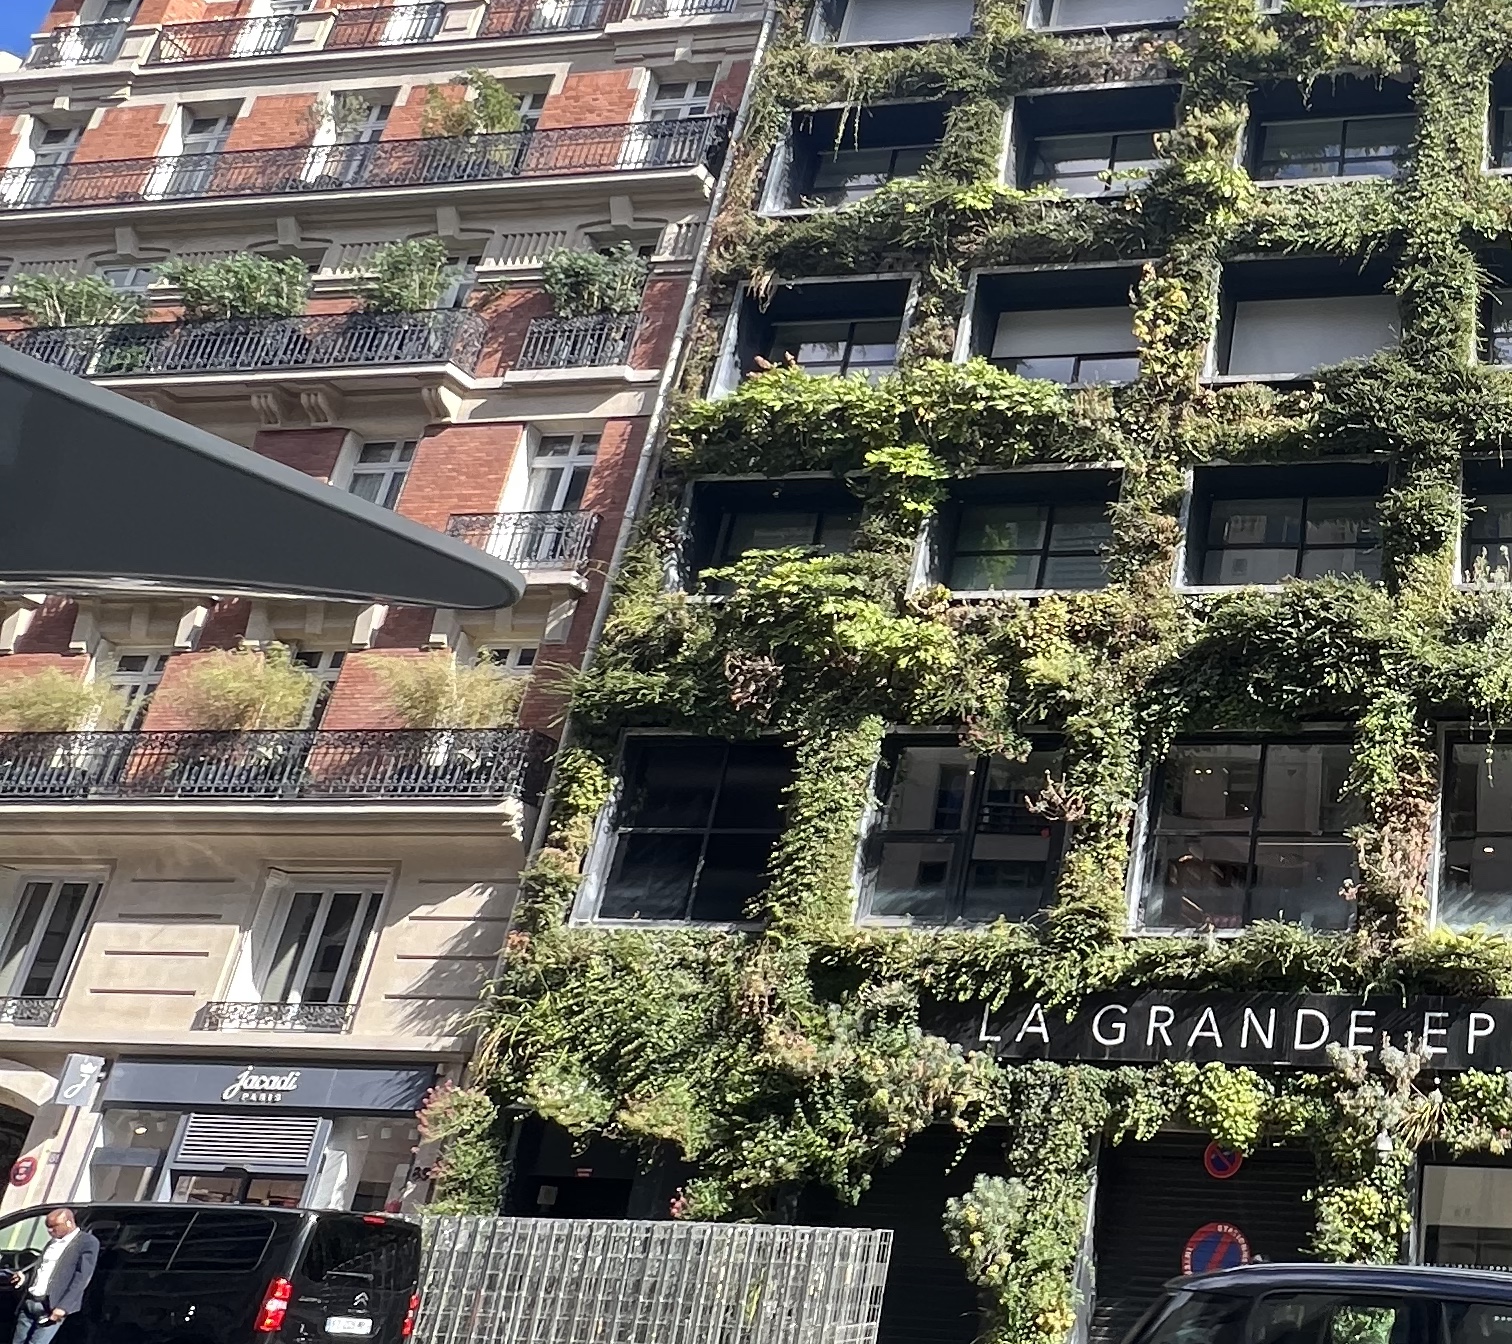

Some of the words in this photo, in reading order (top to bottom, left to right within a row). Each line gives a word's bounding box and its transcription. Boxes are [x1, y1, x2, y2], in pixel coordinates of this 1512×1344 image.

[979, 1002, 1049, 1043] LA
[1092, 1004, 1376, 1052] GRANDE
[240, 1092, 282, 1102] PARIS
